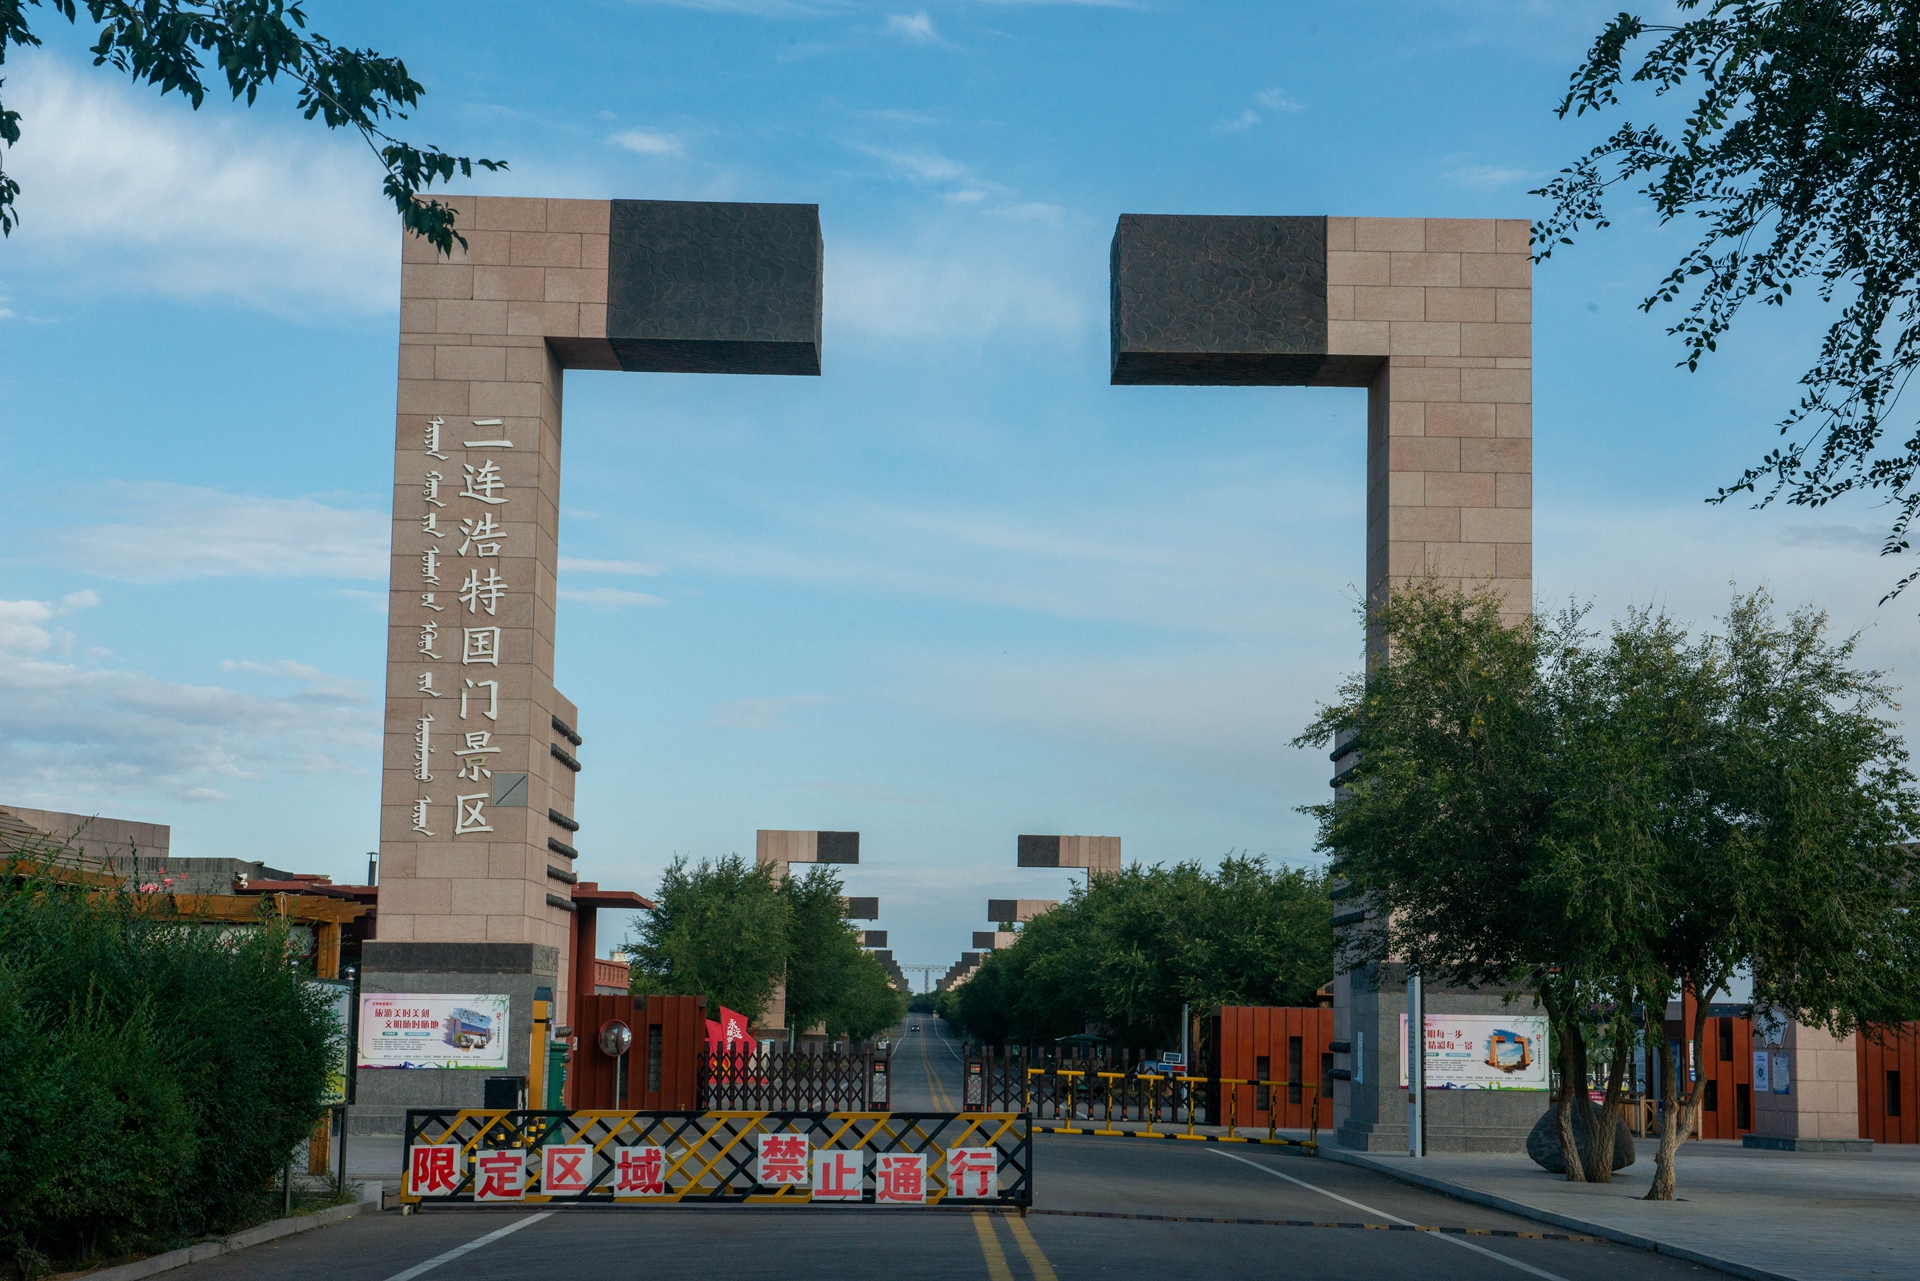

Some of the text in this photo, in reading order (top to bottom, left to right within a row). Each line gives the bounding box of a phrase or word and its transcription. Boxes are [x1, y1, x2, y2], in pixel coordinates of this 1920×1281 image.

[453, 418, 513, 835] 二连浩特国门景区
[385, 1020, 439, 1029] 文明随时随地
[1427, 1030, 1463, 1039] 明每一步
[1427, 1041, 1473, 1050] 精彩每一景
[411, 1136, 996, 1203] 限定区域 禁止通行
